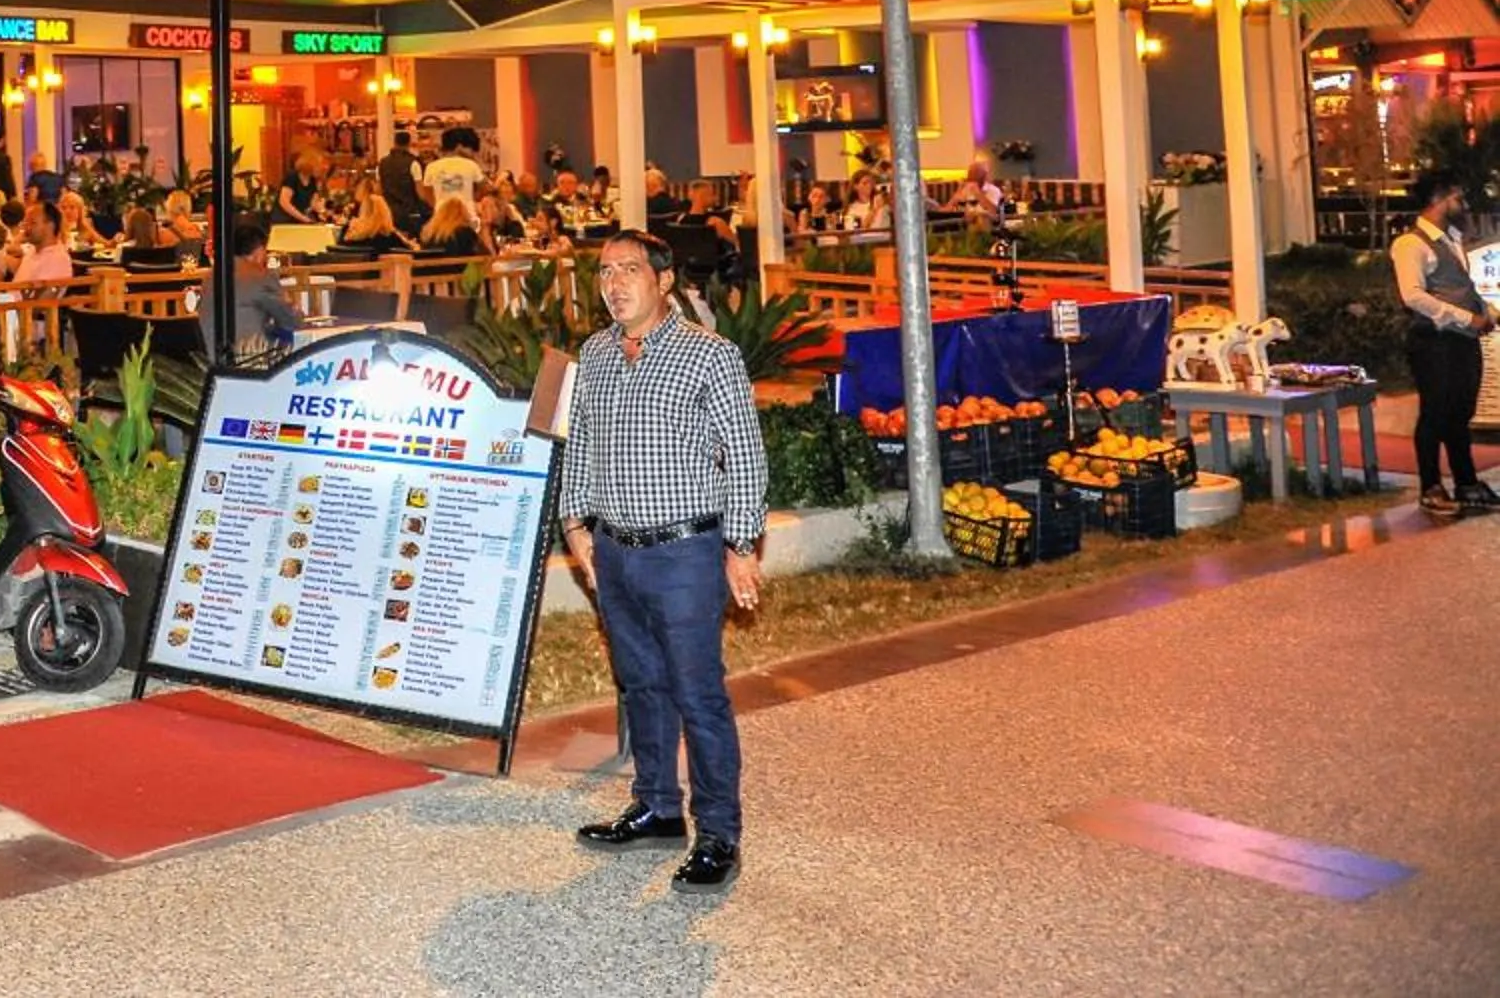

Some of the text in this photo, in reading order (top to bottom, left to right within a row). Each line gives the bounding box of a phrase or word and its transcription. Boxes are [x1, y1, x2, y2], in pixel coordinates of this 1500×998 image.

[36, 19, 69, 42] BAR
[146, 26, 243, 50] COCKTS
[293, 32, 383, 53] SKY SPORT
[287, 393, 465, 430] RESTAANT
